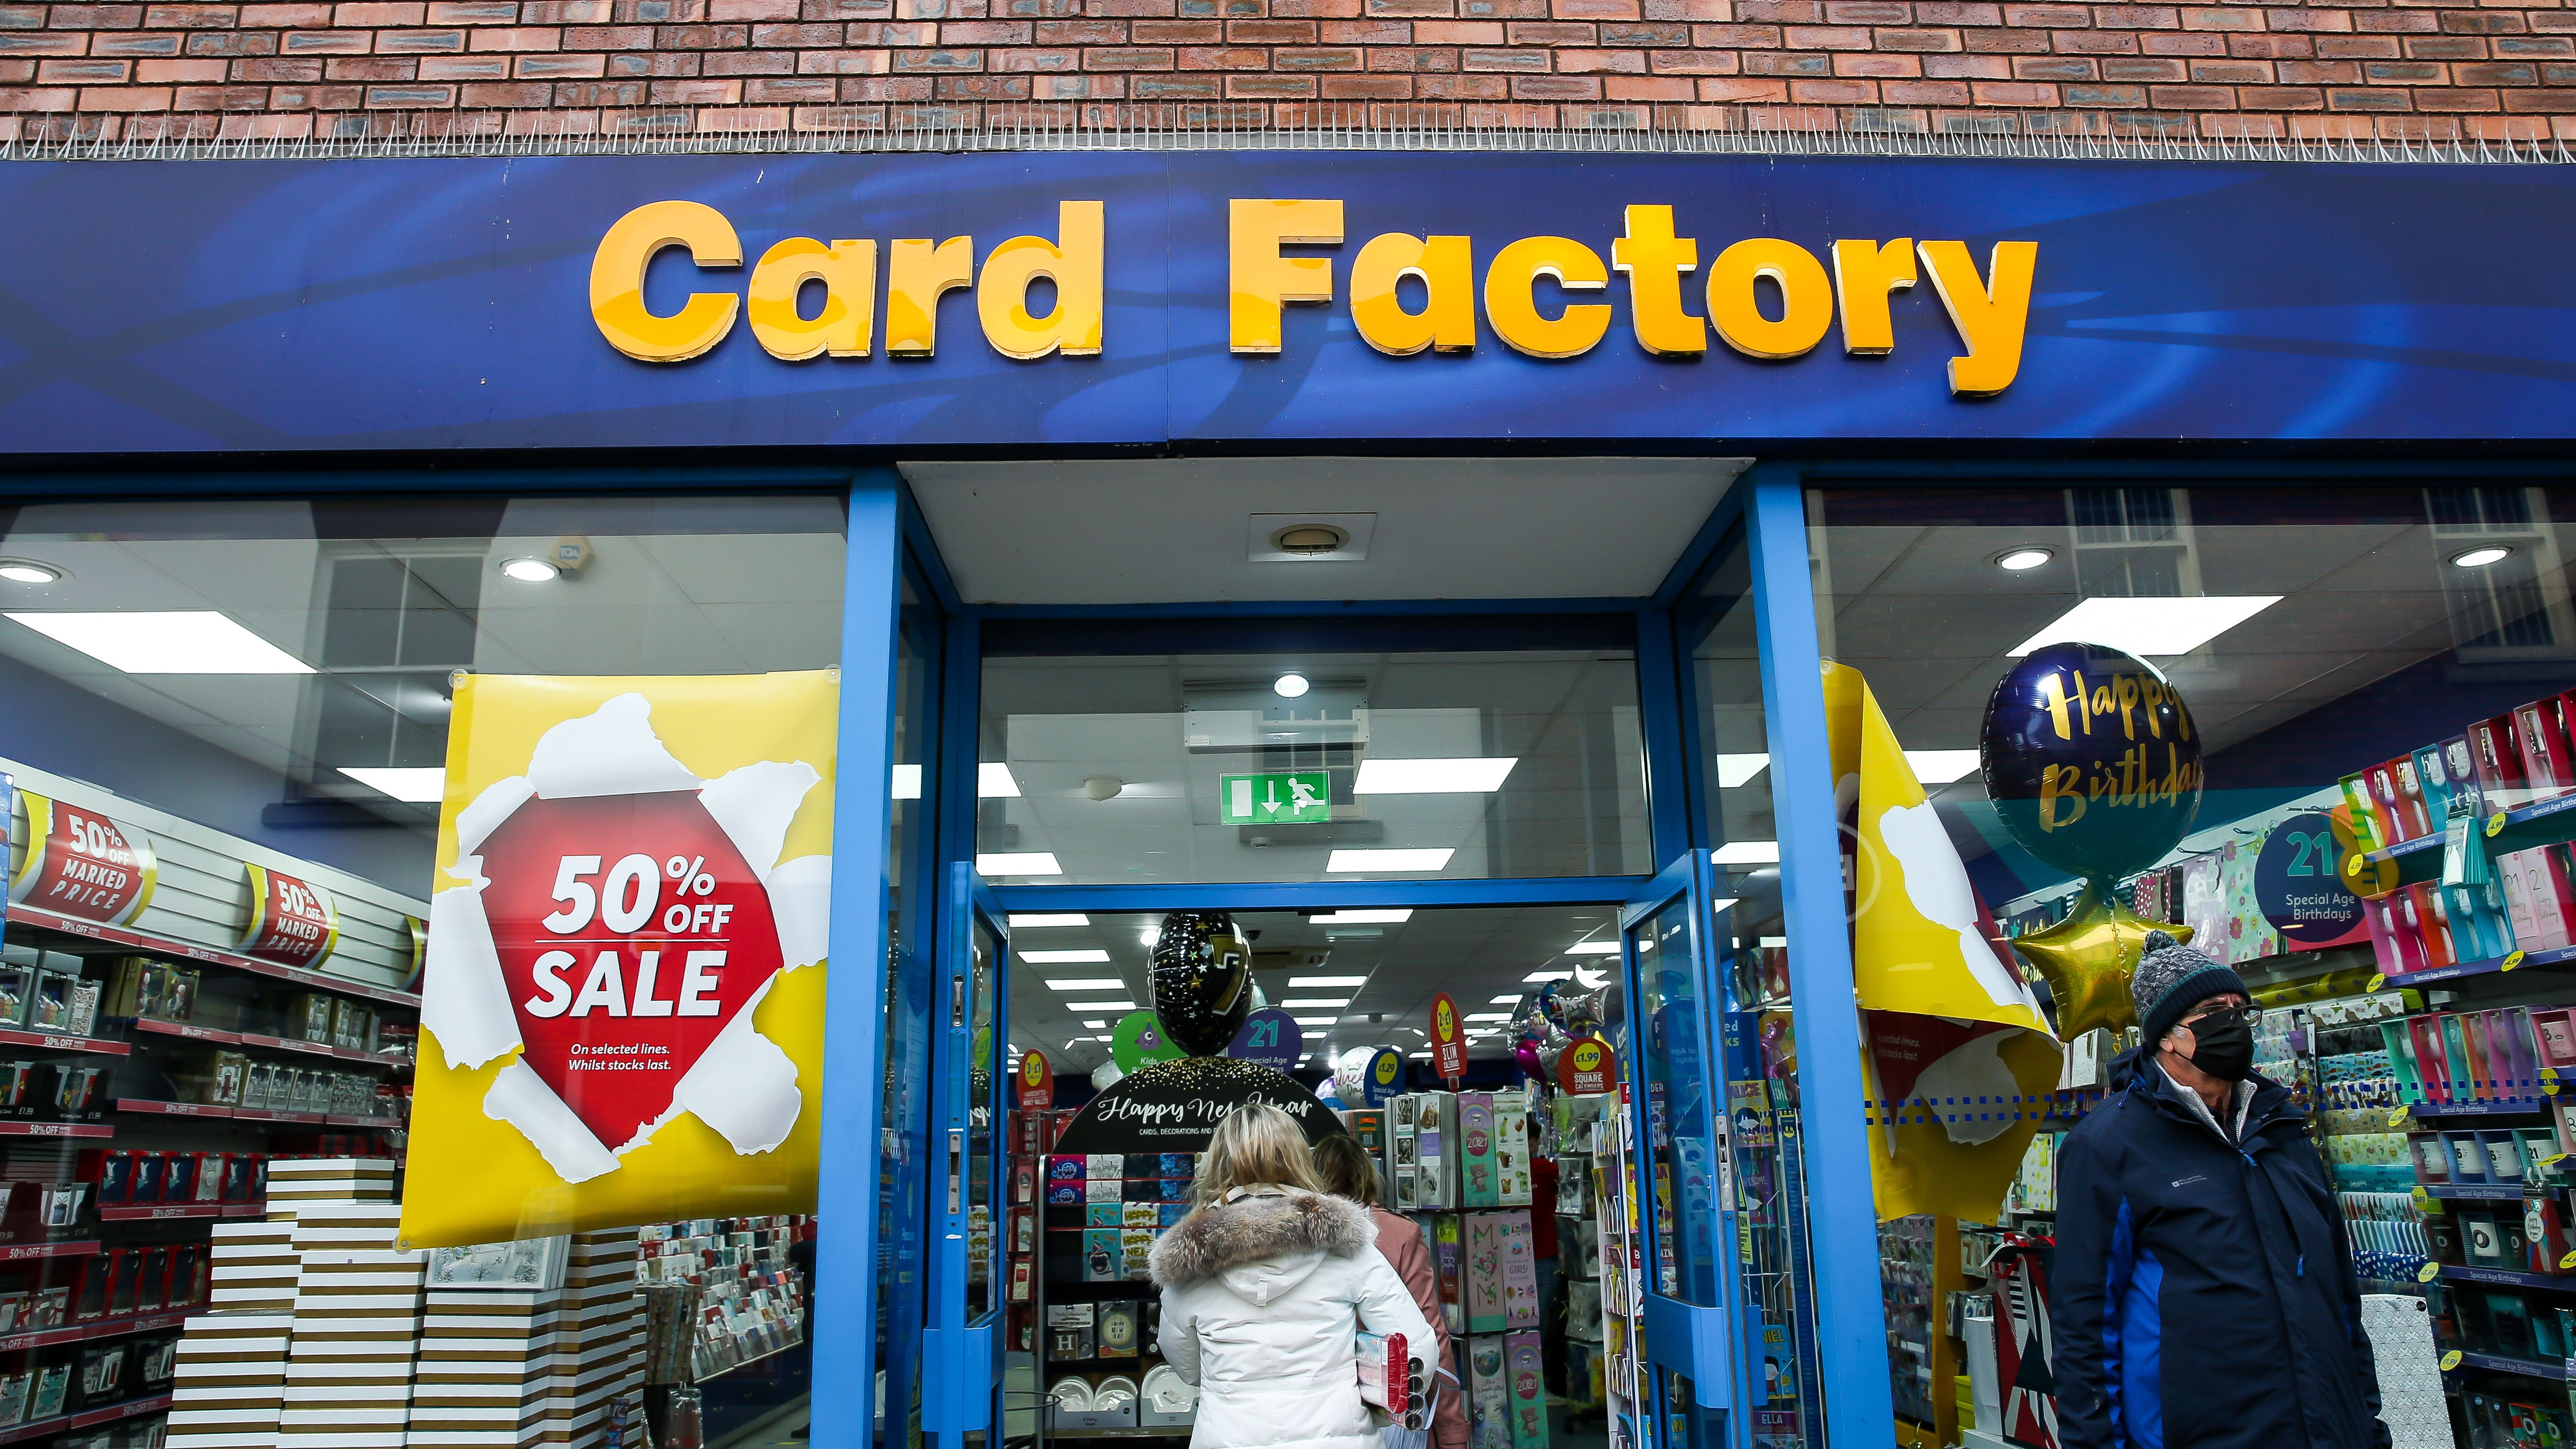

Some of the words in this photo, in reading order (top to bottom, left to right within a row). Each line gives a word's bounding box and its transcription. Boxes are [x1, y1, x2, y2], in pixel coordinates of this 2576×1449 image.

[589, 200, 1104, 361] Card
[1229, 198, 2039, 400] Factory
[2045, 669, 2190, 741] Happy
[2531, 804, 2549, 817] Special
[2550, 801, 2560, 813] Age
[68, 814, 123, 858] 50%
[109, 849, 129, 866] OFF
[2286, 832, 2333, 876] 21
[62, 858, 127, 890] MARKED
[2529, 868, 2547, 891] 21
[2504, 873, 2521, 895] 21
[49, 880, 121, 909] PRICE
[277, 879, 315, 916] 50%
[541, 853, 716, 934] 50%
[2286, 893, 2329, 907] Special
[2332, 893, 2355, 907] Age
[306, 906, 320, 920] OFF
[663, 904, 734, 934] OFF
[2293, 908, 2351, 922] Birthdays
[61, 920, 75, 932] 50%
[76, 924, 89, 934] OFF
[276, 917, 319, 940] MARKED
[267, 935, 314, 956] PRICE
[524, 950, 728, 1018] SALE
[1247, 1020, 1279, 1047] 21
[44, 1036, 60, 1046] 50%
[60, 1039, 73, 1048] OFF
[571, 1044, 589, 1055] On
[591, 1043, 639, 1055] selected
[641, 1043, 670, 1055] lines.
[1442, 1045, 1457, 1061] SLIM
[1575, 1052, 1600, 1063] £1.99
[569, 1059, 606, 1071] Whilst
[608, 1060, 645, 1071] stocks
[647, 1060, 672, 1070] last.
[1574, 1074, 1603, 1083] SQUARE
[1097, 1096, 1183, 1124] Happy
[30, 1125, 45, 1134] 50%
[46, 1126, 59, 1134] OFF
[1467, 1136, 1488, 1148] 2021
[9, 1248, 26, 1258] 50%
[26, 1247, 40, 1256] OFF
[2498, 1274, 2522, 1284] Birthdays
[8, 1338, 22, 1348] OFF
[1057, 1335, 1074, 1351] H
[2488, 1359, 2506, 1368] Special
[2507, 1362, 2517, 1371] Age
[2517, 1364, 2541, 1375] Birthdays
[1517, 1379, 1537, 1391] 2021
[1762, 1414, 1783, 1425] ELLA
